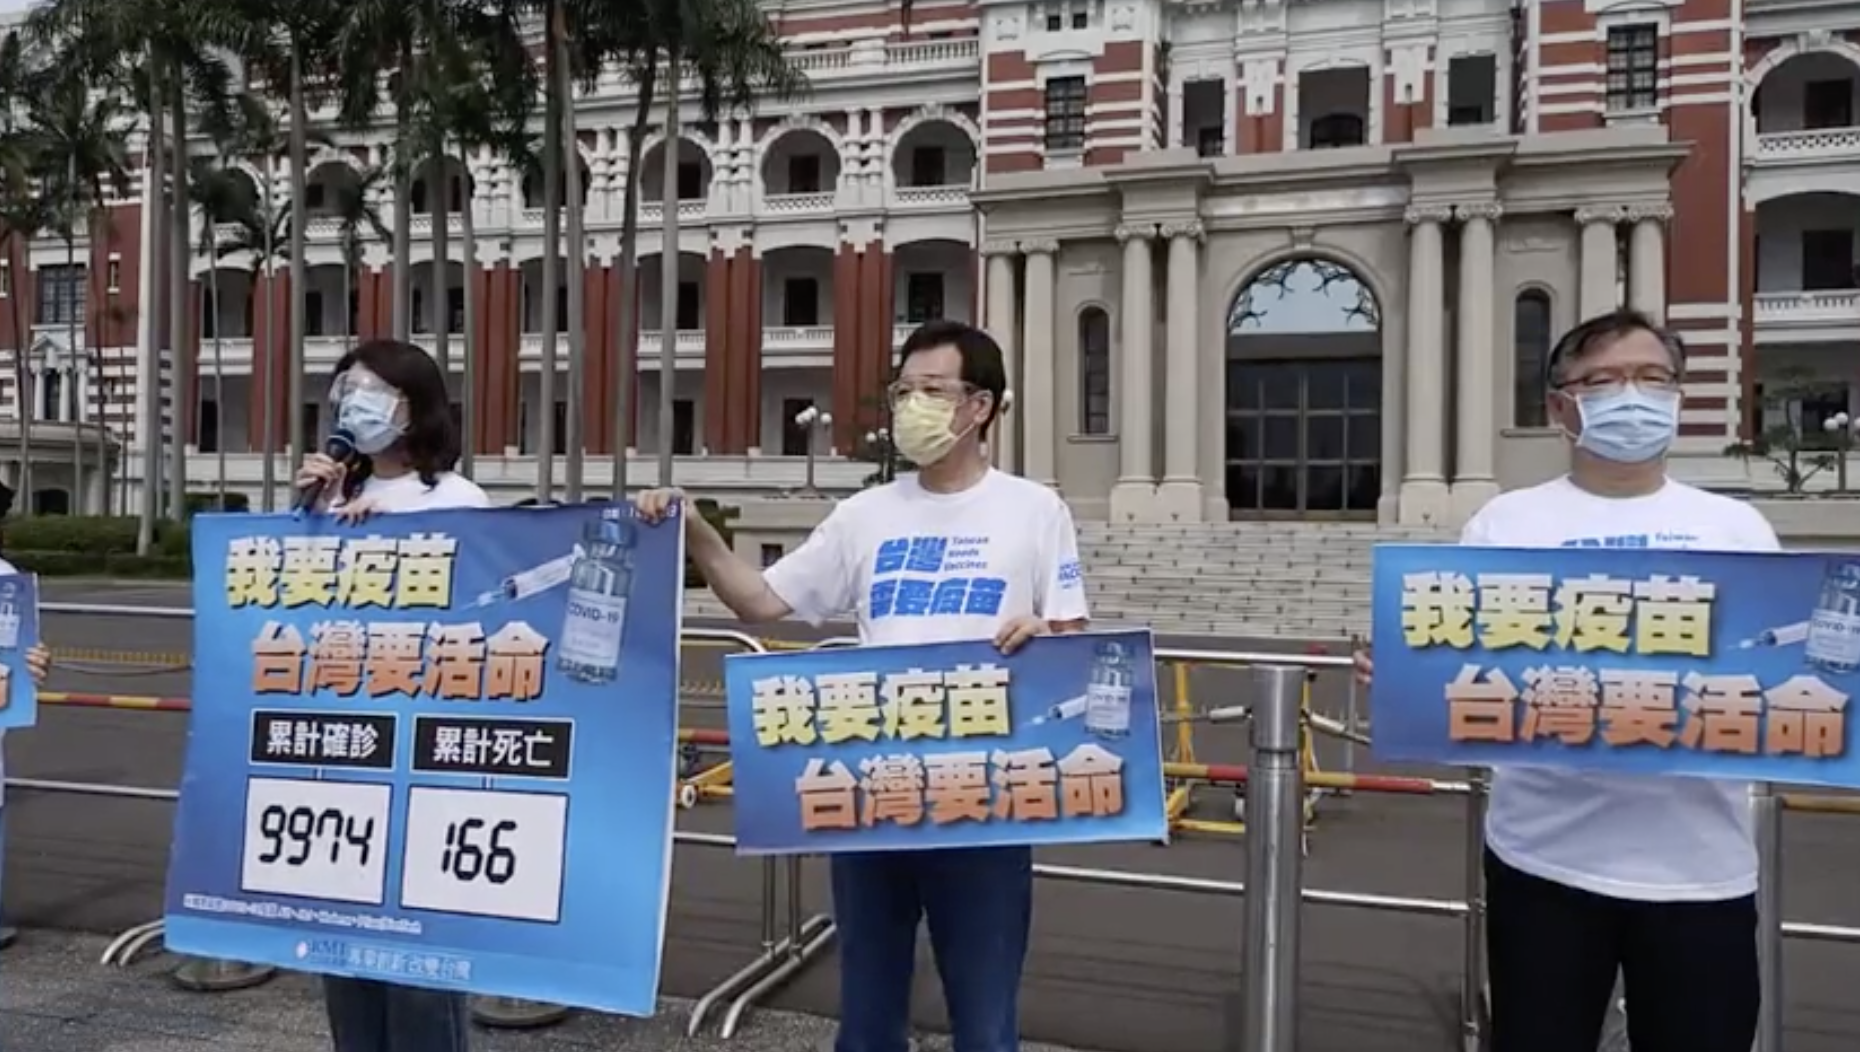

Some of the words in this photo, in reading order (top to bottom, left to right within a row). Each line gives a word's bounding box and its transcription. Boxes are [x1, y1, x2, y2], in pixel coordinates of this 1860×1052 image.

[227, 535, 457, 609] 我要疫苗
[874, 536, 948, 574] 台灣
[950, 536, 990, 545] Taiwan
[569, 604, 619, 622] COVID-19
[1402, 571, 1716, 656] 我要疫苗
[251, 621, 548, 700] 台灣要活命
[752, 664, 1010, 746] 我要疫苗
[1445, 663, 1850, 757] 台灣要活命
[266, 721, 379, 759] 累計確診
[433, 727, 555, 768] 累計死亡
[796, 743, 1122, 831] 台灣要活命
[258, 805, 375, 866] 9974
[441, 820, 517, 884] 166
